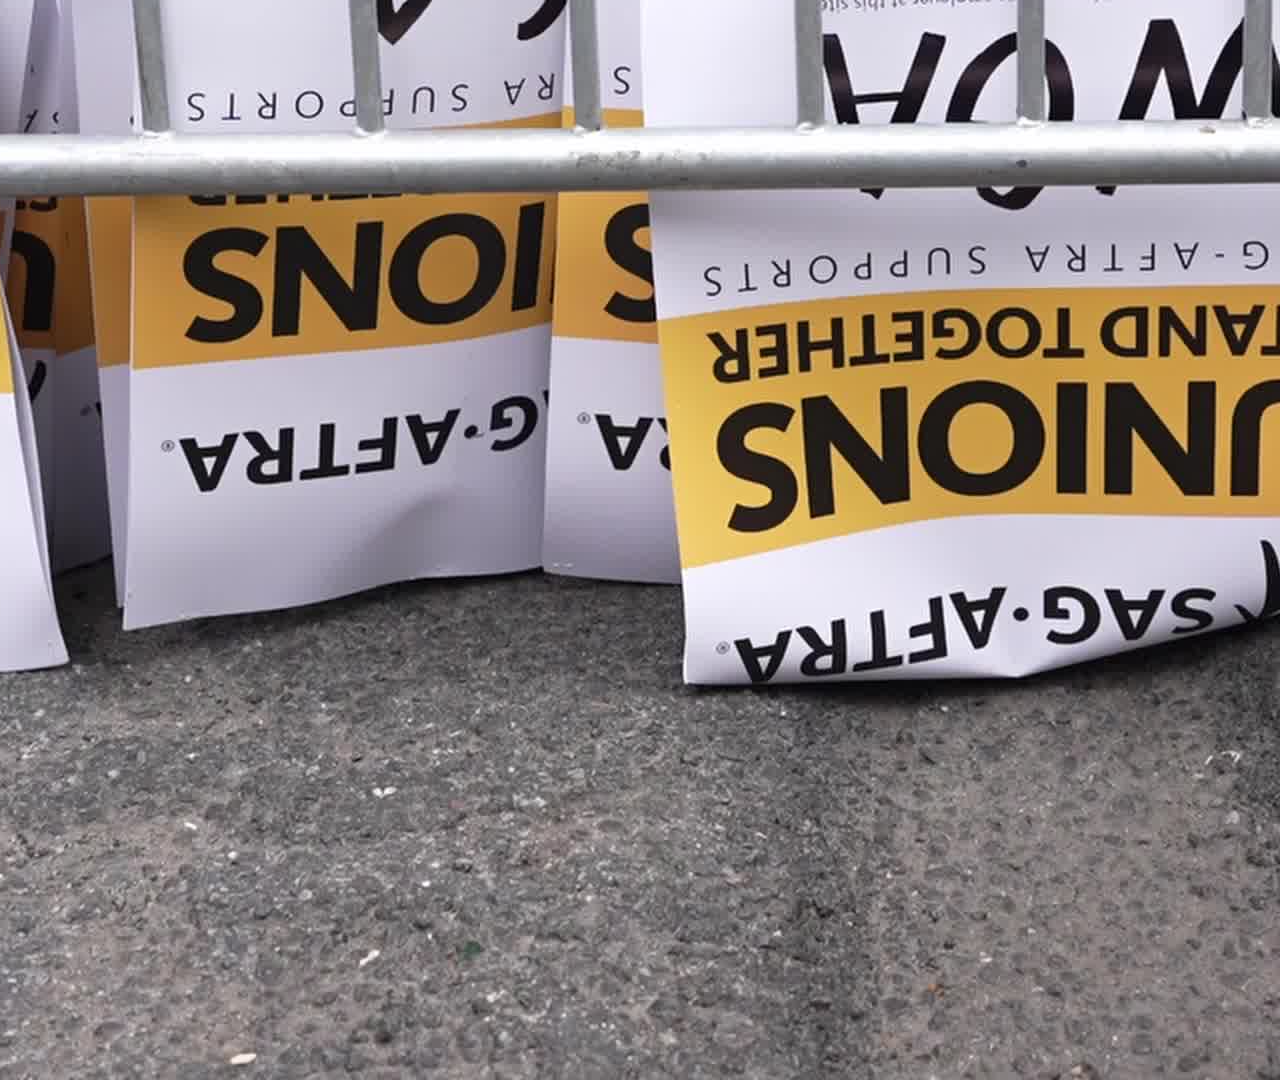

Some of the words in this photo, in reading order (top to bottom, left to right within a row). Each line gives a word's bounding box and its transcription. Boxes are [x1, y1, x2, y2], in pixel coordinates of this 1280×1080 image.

[183, 201, 552, 342] IONS
[702, 245, 986, 298] SUPPORTS
[707, 308, 1072, 385] TOGETHER
